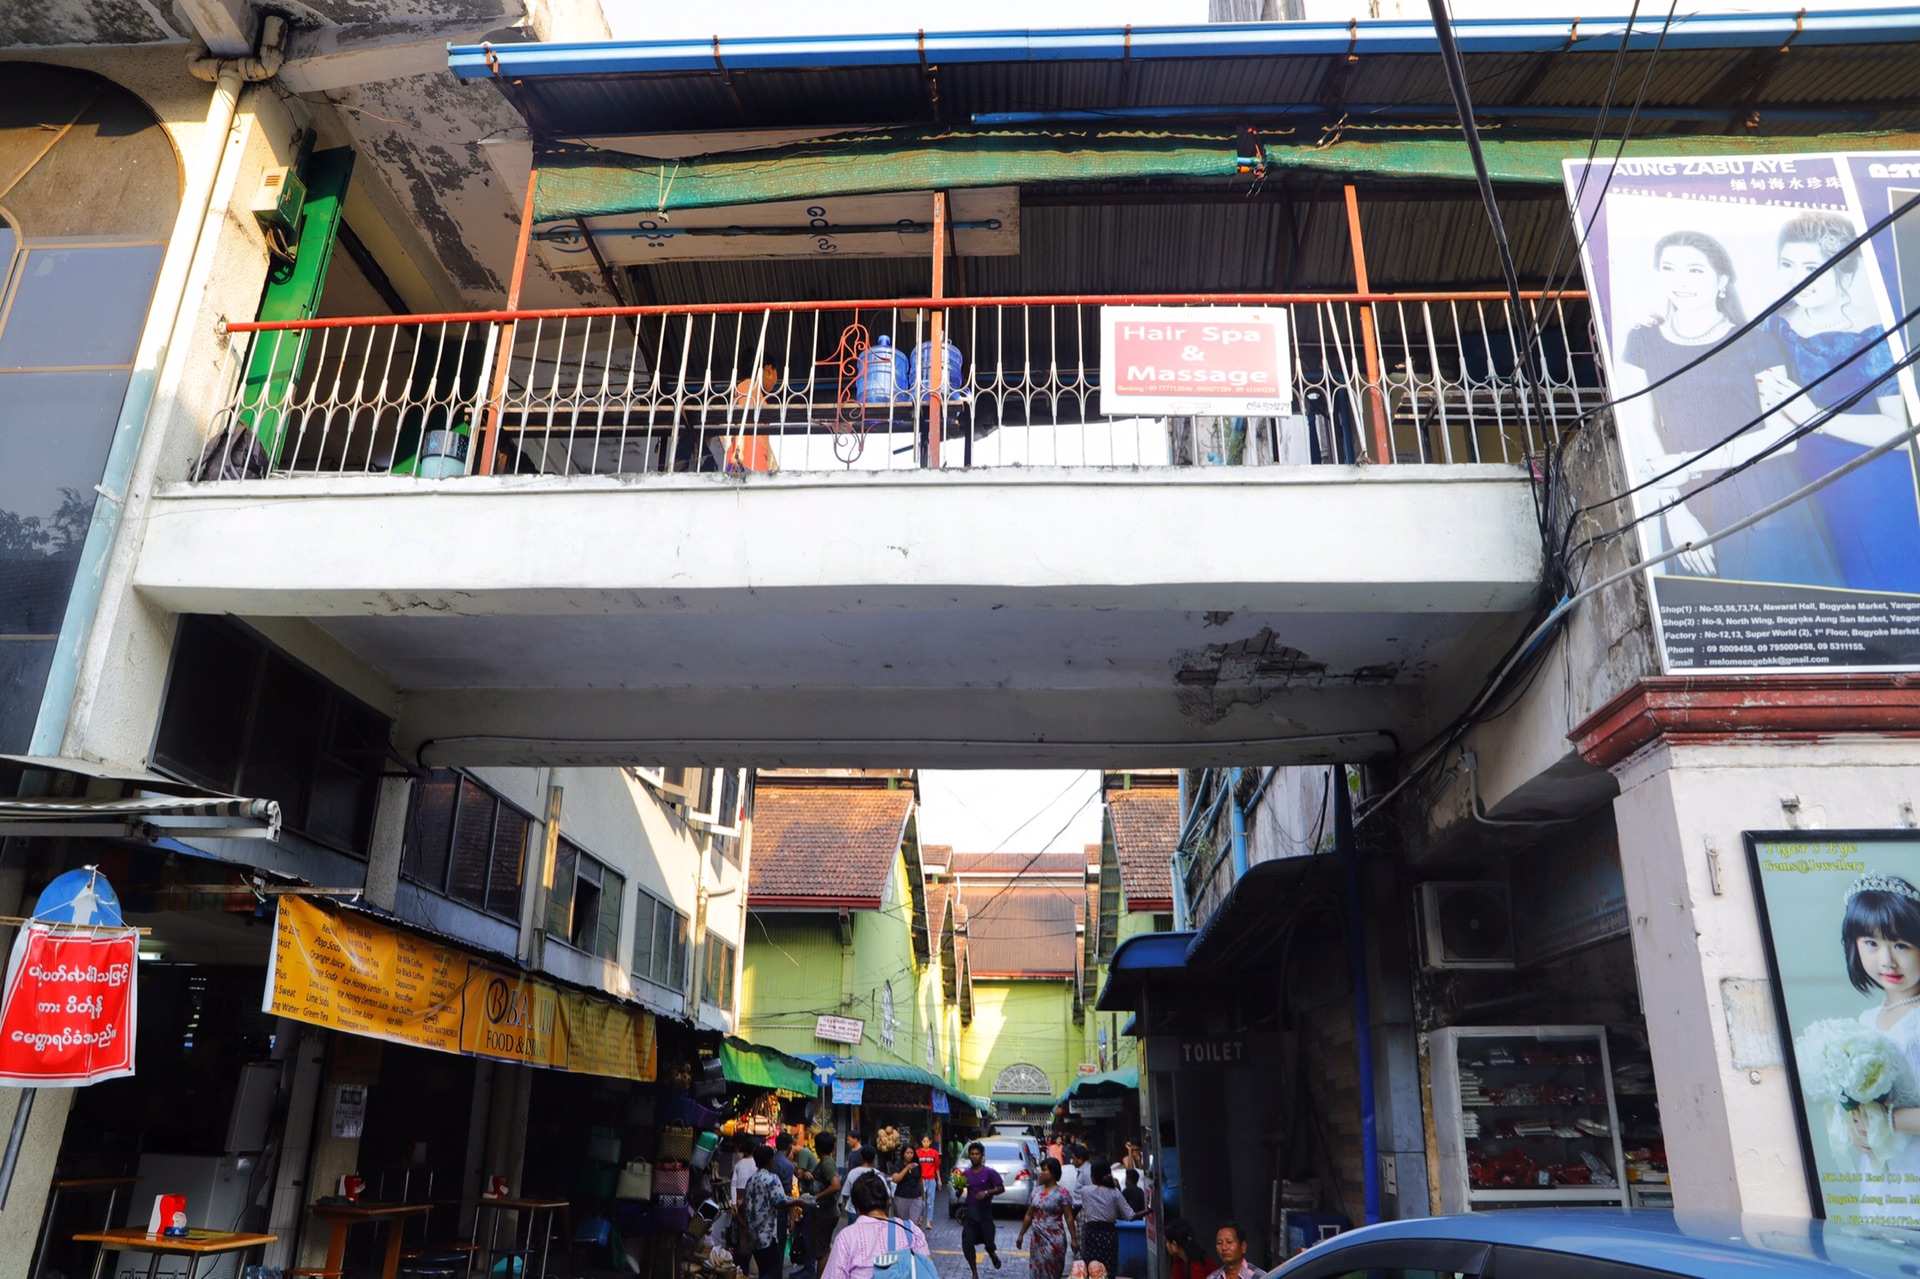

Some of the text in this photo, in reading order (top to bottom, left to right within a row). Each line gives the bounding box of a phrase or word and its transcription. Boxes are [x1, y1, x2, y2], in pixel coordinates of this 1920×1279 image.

[1612, 160, 1796, 176] AUNG ZABU AYE
[1730, 177, 1844, 191] 缅甸海水珍珠
[1124, 326, 1261, 345] Hair Spa
[1181, 345, 1205, 361] &
[1127, 366, 1268, 386] Massage
[1660, 605, 1692, 614] Shop(1)
[1763, 603, 1797, 611] Nawarat
[1799, 602, 1817, 611] Hall,
[1819, 602, 1856, 611] Bogyoke
[1858, 602, 1889, 611] Market,
[1663, 618, 1695, 627] Shop(2)
[1702, 617, 1724, 626] No-9,
[1726, 617, 1749, 625] North
[1751, 617, 1775, 626] Wing,
[1776, 616, 1813, 625] Bogyoke
[1814, 615, 1837, 624] Aung
[1839, 615, 1856, 623] San
[1857, 615, 1889, 623] Market,
[1665, 631, 1696, 640] Factory
[1745, 630, 1770, 639] Super
[1771, 629, 1796, 637] World
[1825, 628, 1850, 637] Floor,
[1851, 628, 1889, 638] Bogyoke
[1667, 646, 1694, 654] Phone
[1757, 644, 1768, 652] 09
[1669, 658, 1693, 666] Email
[314, 936, 327, 949] Pop
[310, 949, 345, 969] Orange Juice
[325, 969, 338, 981] Soda
[279, 985, 296, 998] Sweat
[351, 979, 367, 991] Honey
[367, 984, 382, 994] Lemon
[306, 991, 318, 1004] Lime
[345, 991, 362, 1004] Honey
[362, 995, 378, 1007] Lemon
[282, 1002, 300, 1015] Water
[303, 1007, 329, 1021] Green Tea
[486, 1029, 515, 1053] FOOD
[516, 1036, 524, 1054] &
[1182, 1041, 1243, 1063] TOILET
